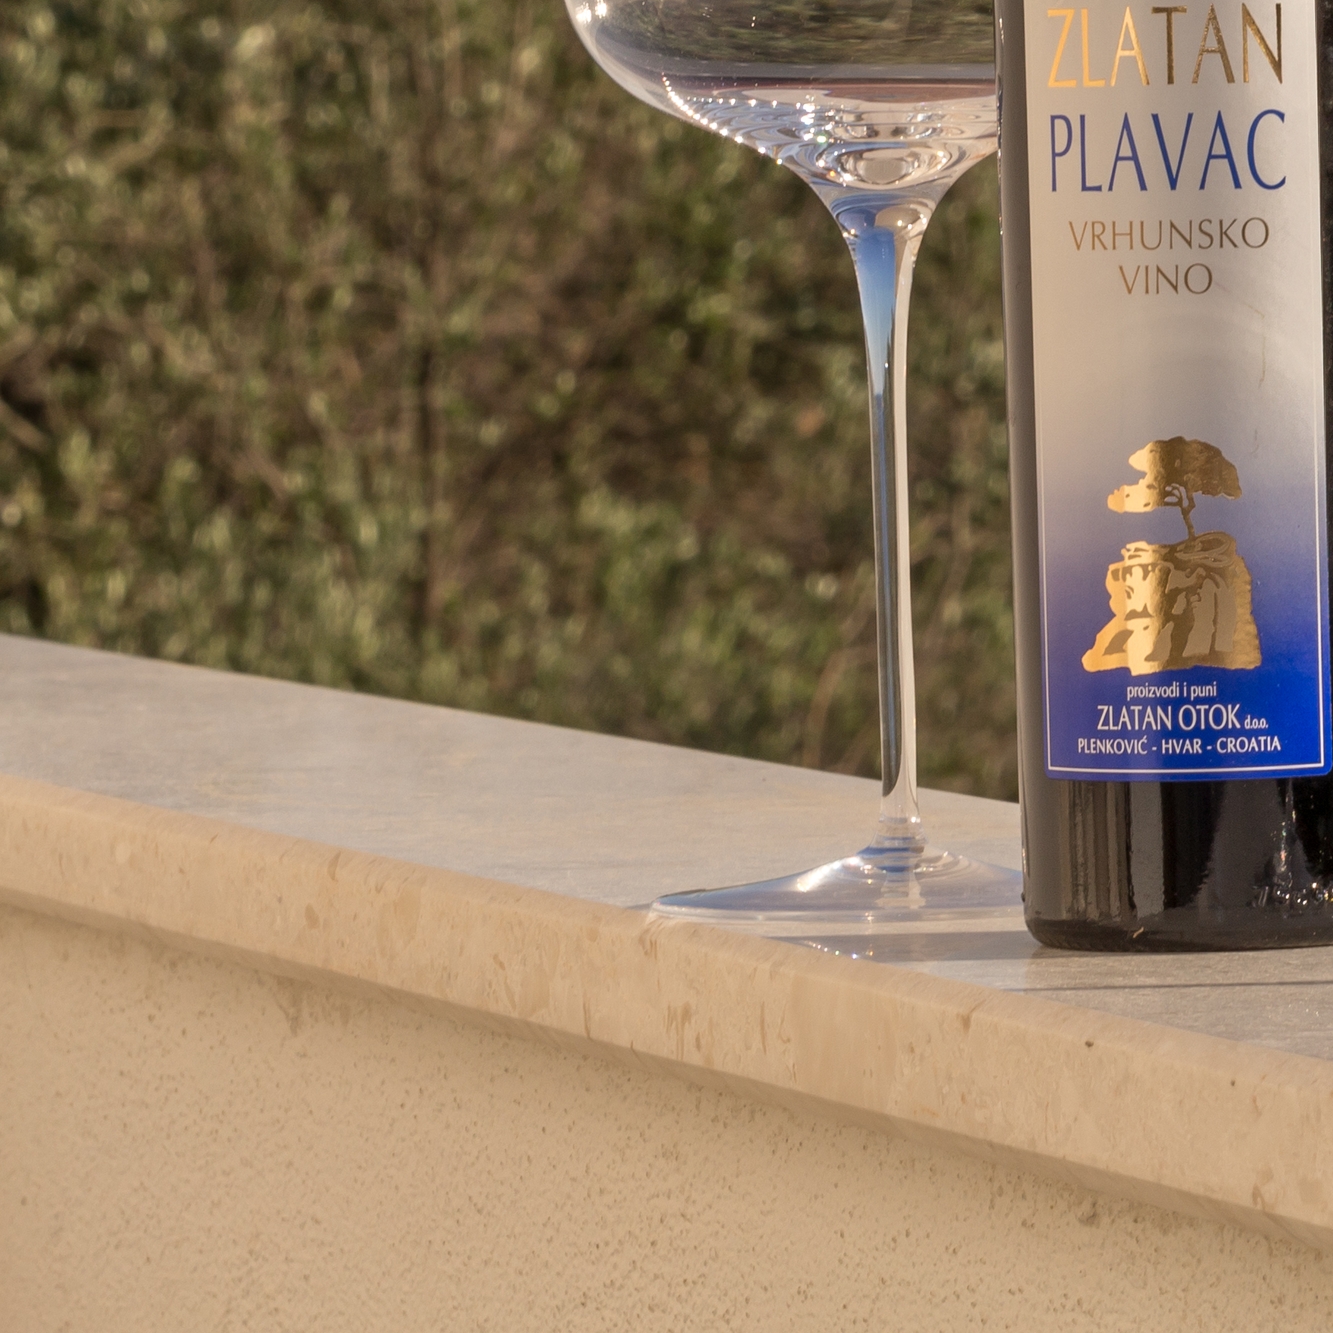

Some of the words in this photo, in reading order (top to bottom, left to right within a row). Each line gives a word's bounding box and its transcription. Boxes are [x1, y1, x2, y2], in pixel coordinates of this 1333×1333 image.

[1047, 2, 1283, 87] ZLATAN
[1050, 109, 1286, 192] PLAVAC
[1068, 217, 1269, 250] VRHUNSKO
[1118, 264, 1213, 294] VINO
[1126, 682, 1180, 701] proizvodi
[1183, 682, 1188, 697] i
[1190, 681, 1217, 701] puni
[1097, 705, 1172, 731] ZLATAN
[1178, 703, 1241, 730] OTOK
[1244, 715, 1268, 729] d.o.o.
[1078, 735, 1148, 754] PLENKOVIĆ
[1162, 738, 1202, 754] HVAR
[1216, 736, 1281, 753] CROATIA
